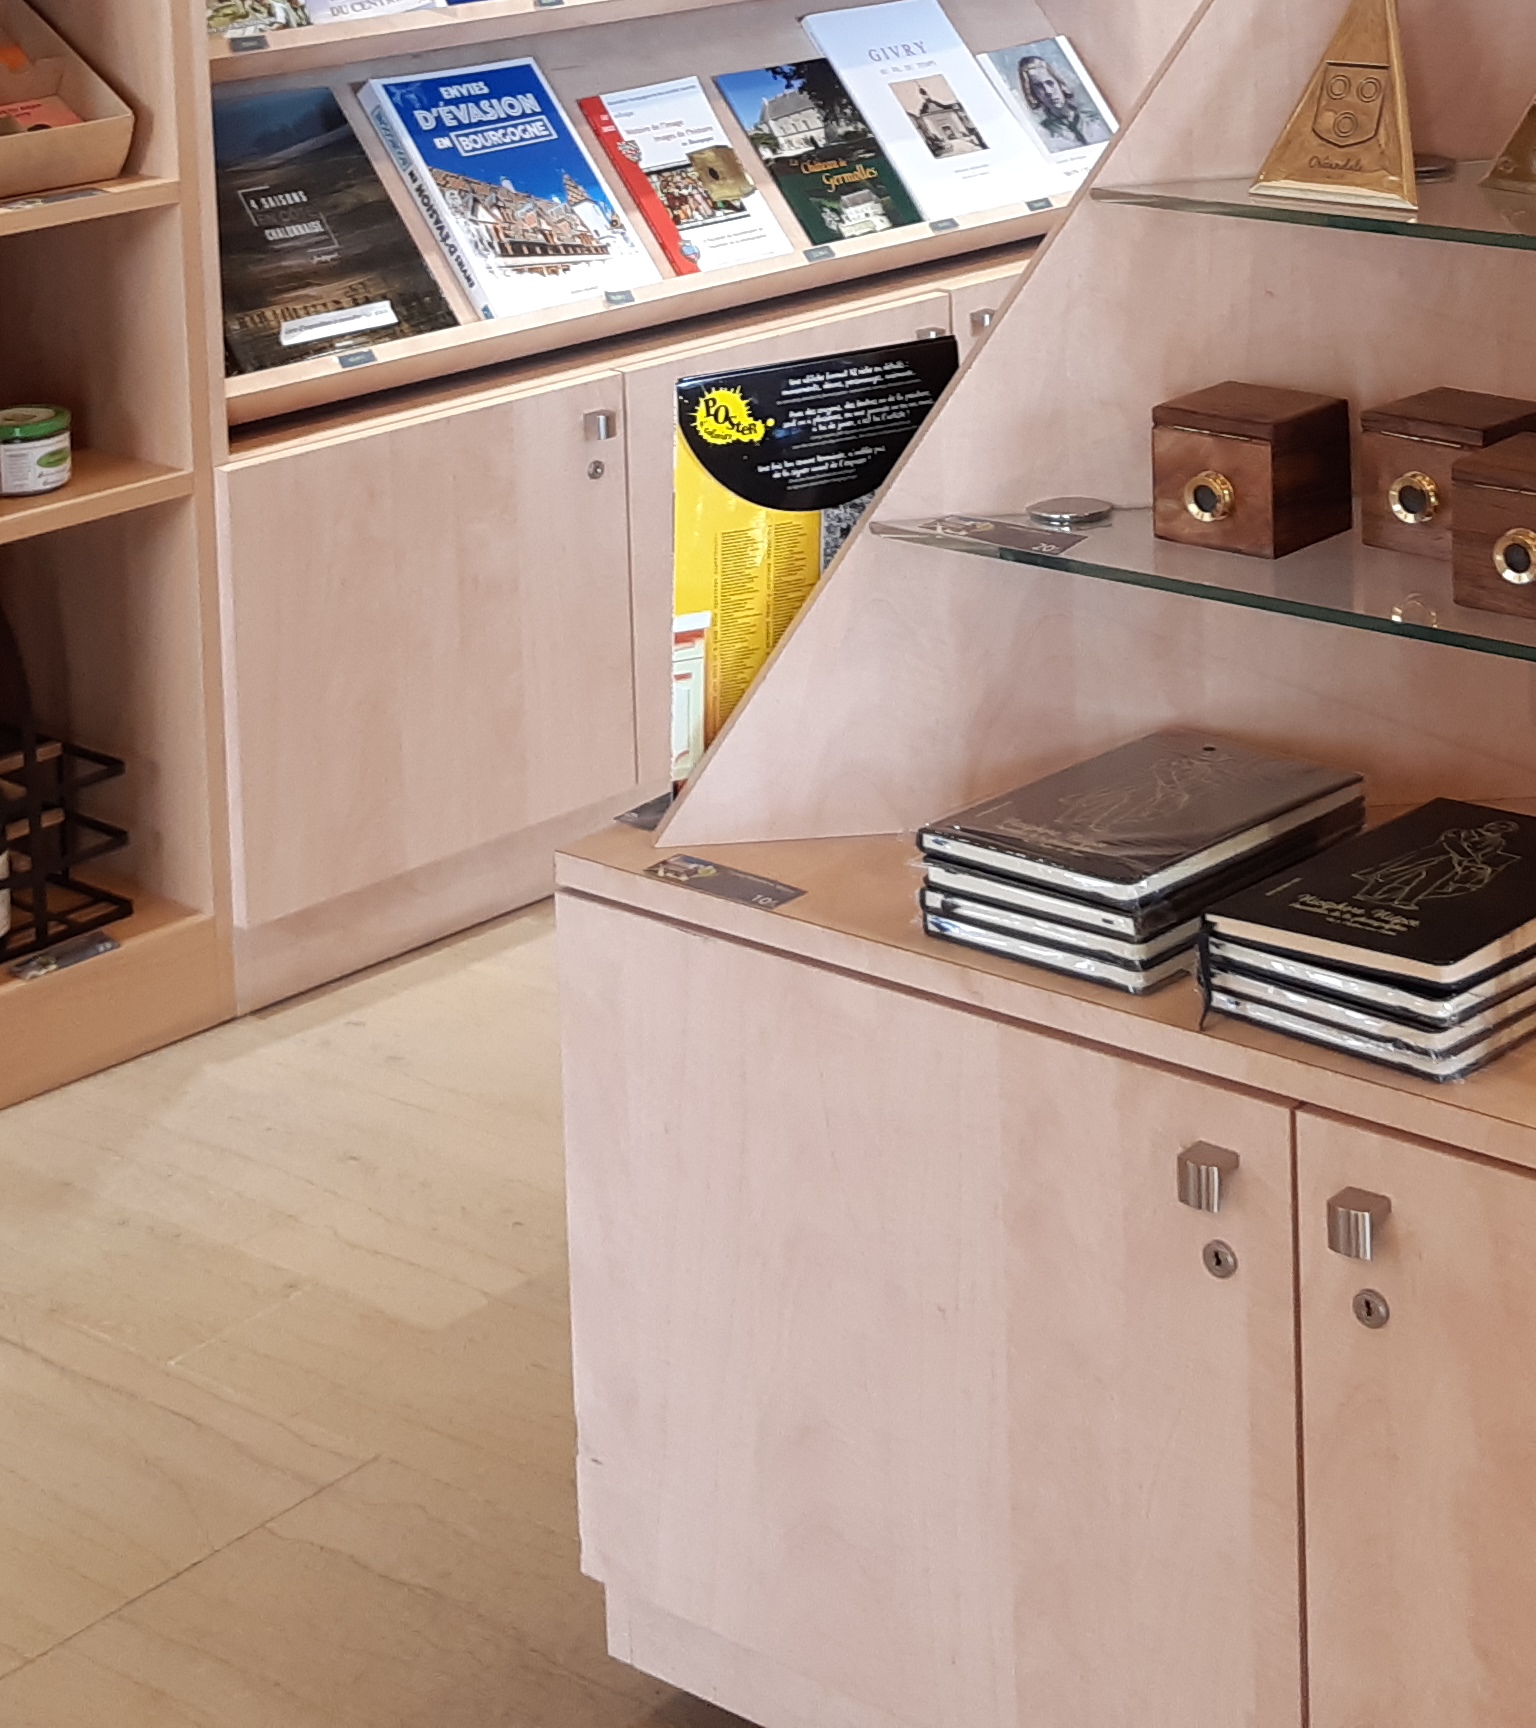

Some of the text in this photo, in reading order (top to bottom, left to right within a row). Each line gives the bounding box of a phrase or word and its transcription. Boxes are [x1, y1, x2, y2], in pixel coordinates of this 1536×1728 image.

[329, 5, 353, 18] DU
[867, 40, 928, 64] GIVRY
[438, 81, 490, 101] ENVIES
[413, 93, 543, 131] D'ÉVASION
[432, 121, 550, 152] EN BOURGOGNE
[821, 165, 878, 193] Germolles
[261, 190, 309, 210] SAISONS
